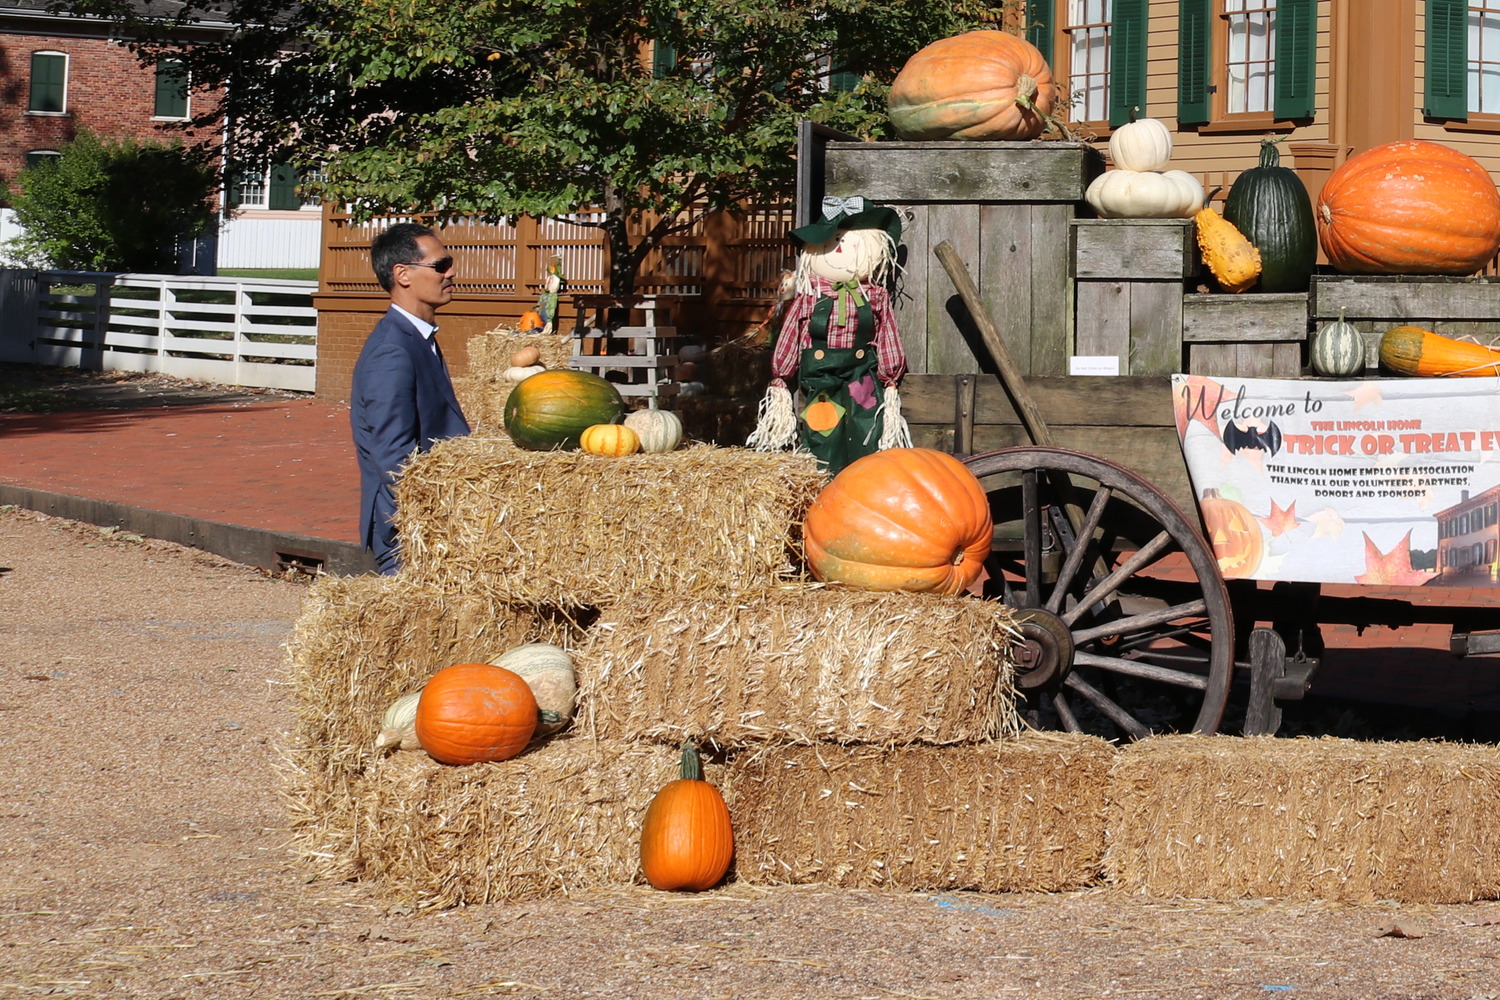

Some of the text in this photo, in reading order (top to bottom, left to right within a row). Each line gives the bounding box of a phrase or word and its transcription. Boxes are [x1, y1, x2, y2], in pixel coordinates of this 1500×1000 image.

[1181, 384, 1323, 421] Welcome to
[1310, 419, 1422, 431] THE LINCOLN HOME
[1283, 433, 1356, 455] TRICK
[1360, 434, 1395, 455] OR
[1399, 431, 1476, 454] TREAT
[1266, 464, 1474, 476] THE LINCOLN HOME EMPLOYEE ASSOCIATION
[1270, 475, 1471, 488] THANKS ALL OUR VOLUNTEERS, PARTNERS,
[1314, 489, 1426, 498] DONORS AND SPONSORS
